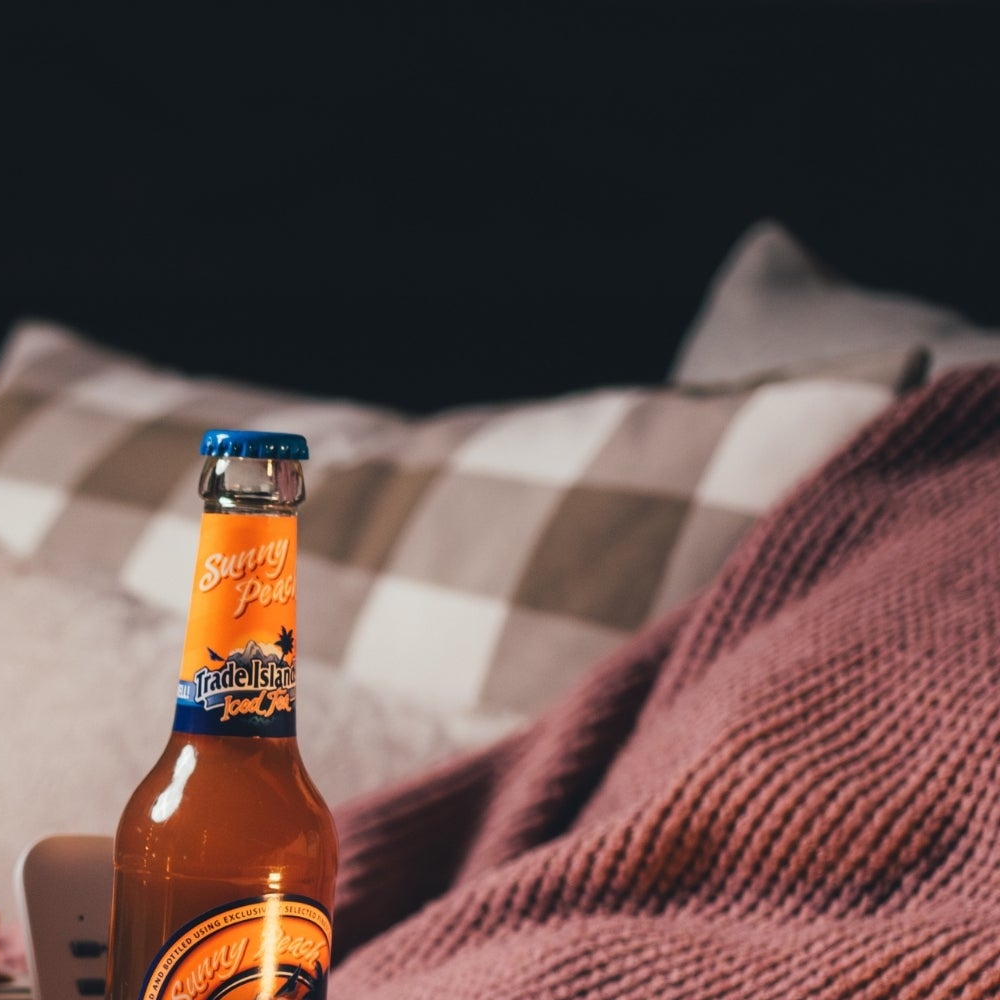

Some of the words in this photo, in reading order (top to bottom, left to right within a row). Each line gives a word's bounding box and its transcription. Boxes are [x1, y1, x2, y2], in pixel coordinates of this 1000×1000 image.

[199, 538, 289, 593] Sunny
[220, 689, 267, 721] Iced
[152, 971, 164, 990] AND
[163, 937, 192, 970] BOTTLED
[193, 919, 220, 939] USING
[223, 905, 281, 923] EXCLUSIV
[285, 905, 317, 919] SELECTED
